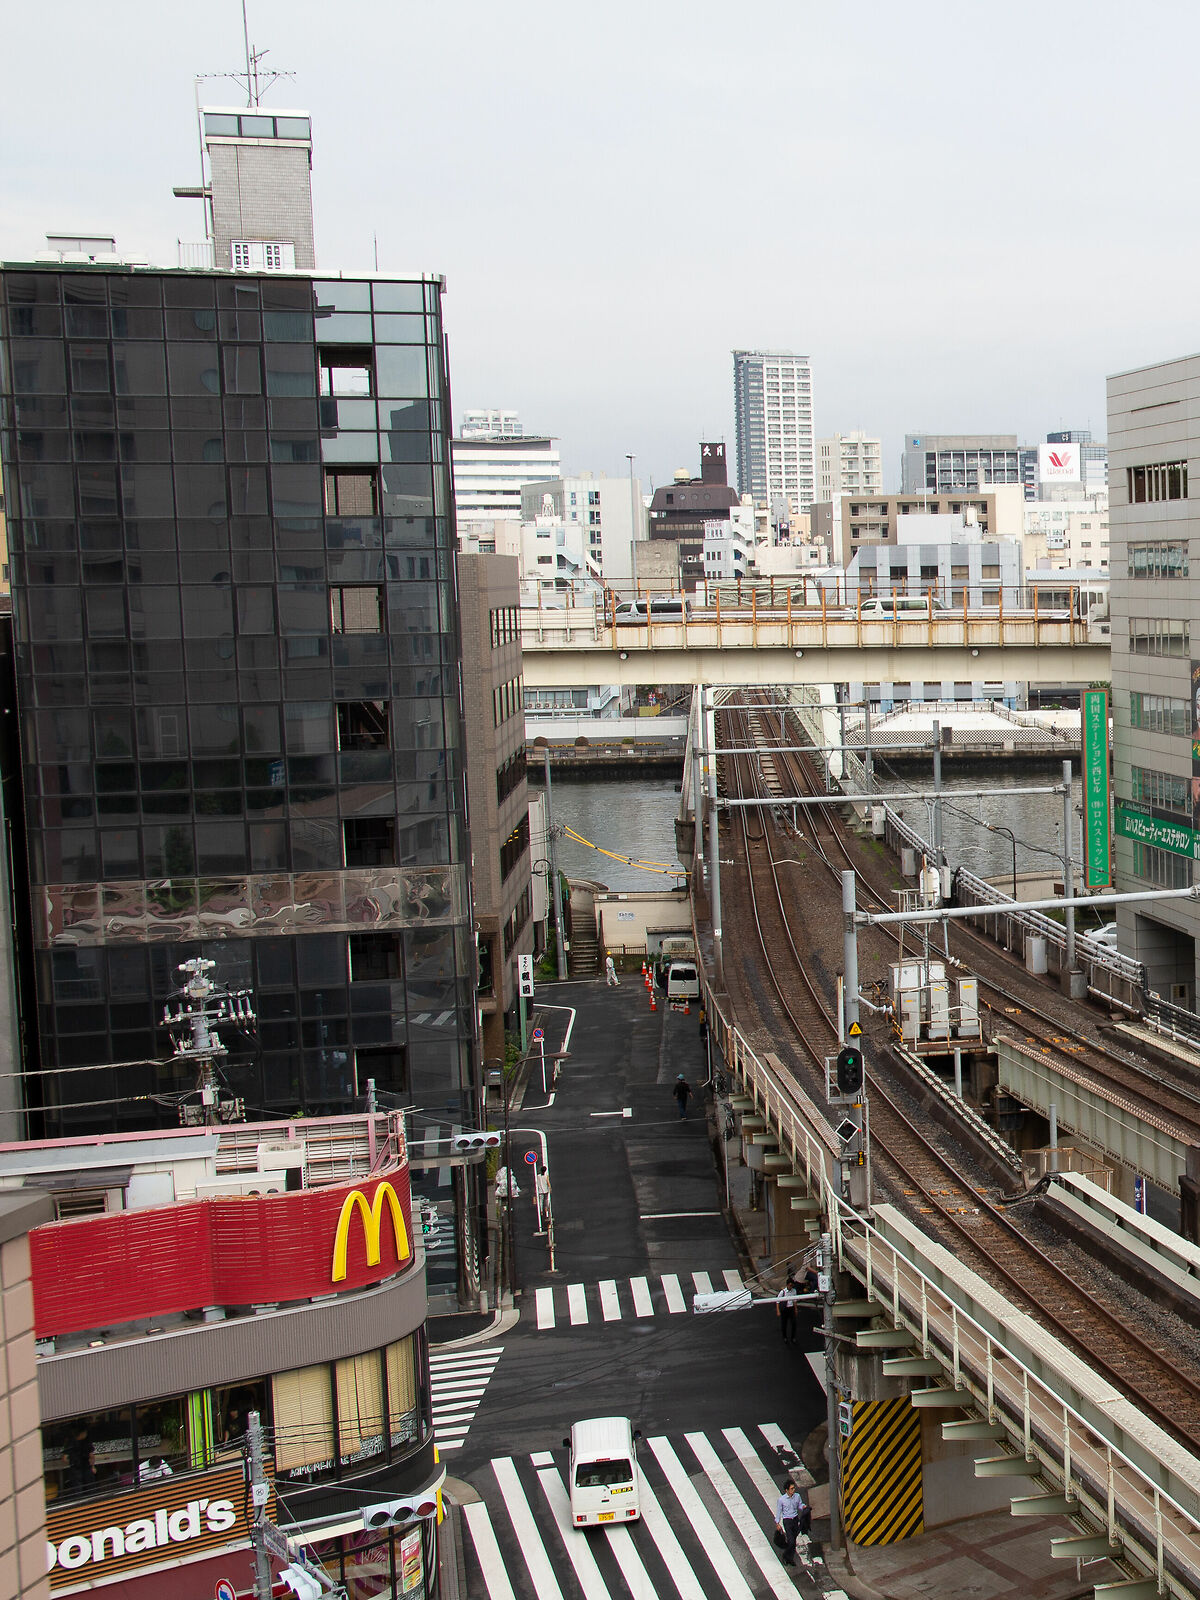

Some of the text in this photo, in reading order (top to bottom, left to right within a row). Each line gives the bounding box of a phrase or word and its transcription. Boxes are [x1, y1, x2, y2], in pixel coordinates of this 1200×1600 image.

[702, 445, 723, 457] 久月
[1125, 816, 1190, 850] ロハスビューティーエステサロン
